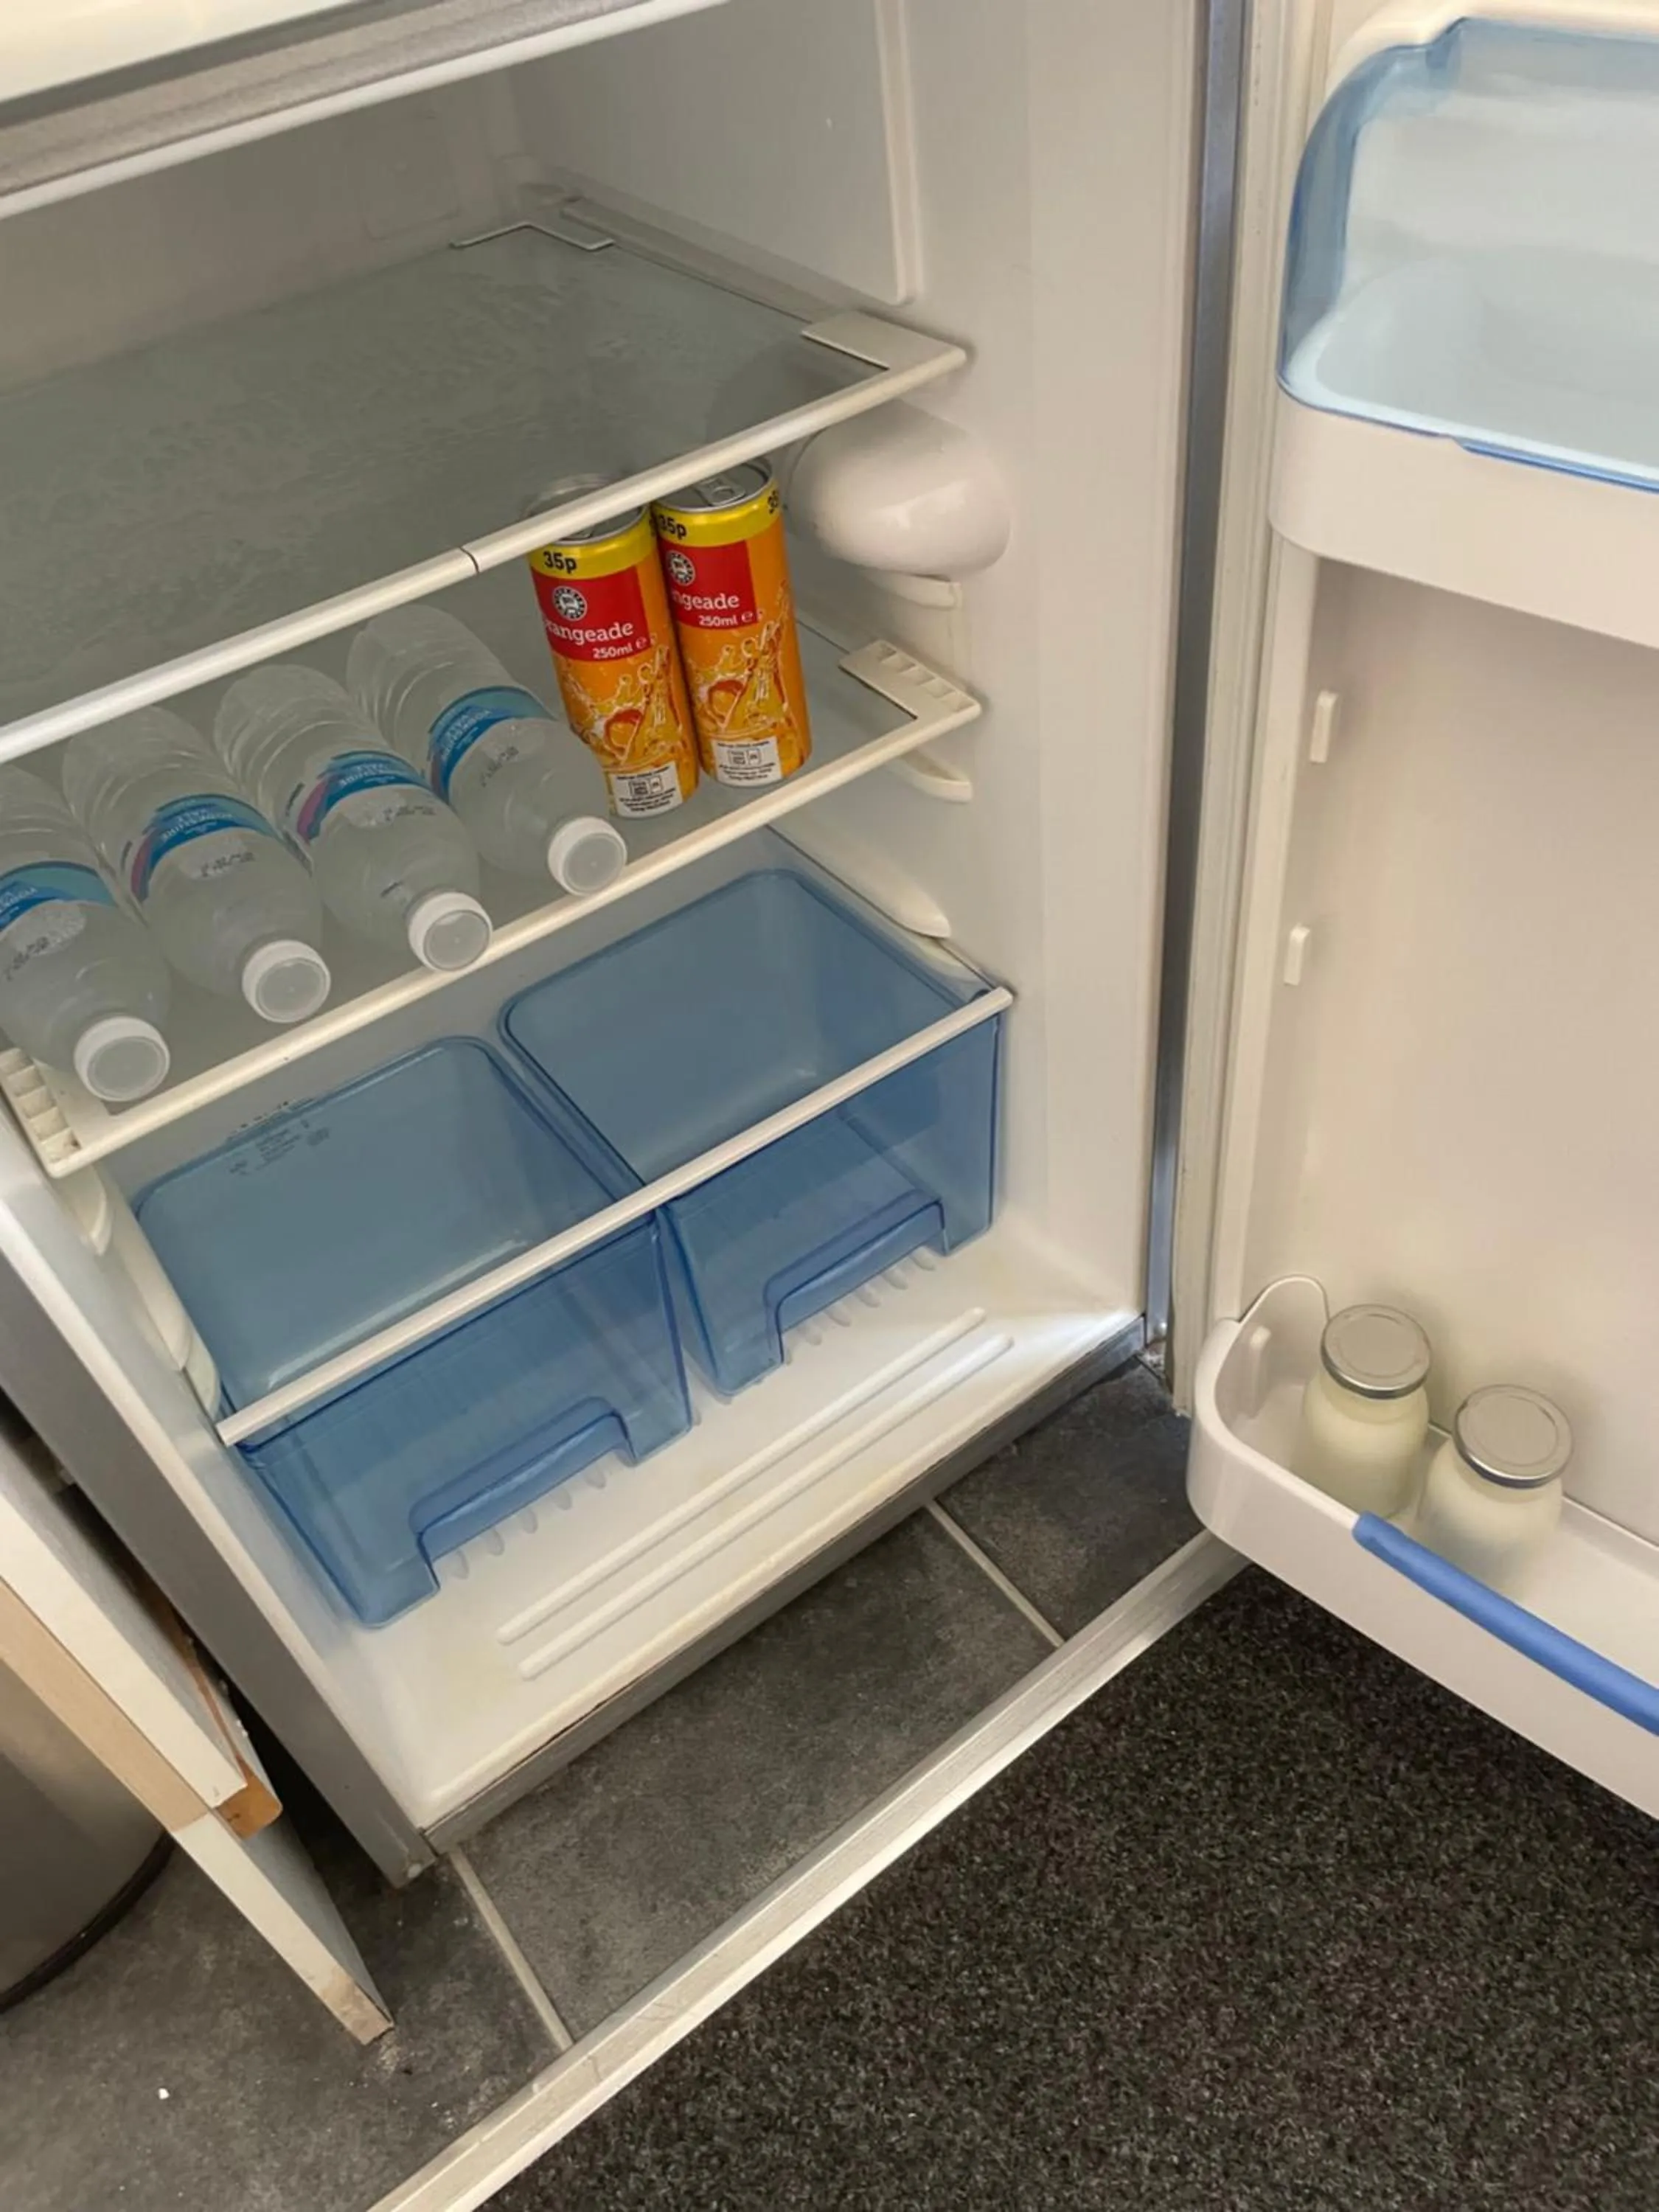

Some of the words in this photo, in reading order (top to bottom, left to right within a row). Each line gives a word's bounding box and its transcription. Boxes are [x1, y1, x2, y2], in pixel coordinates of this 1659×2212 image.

[658, 515, 687, 540] 35p
[543, 551, 577, 574] 35p
[672, 591, 740, 611] ngeade
[699, 615, 738, 627] 250ml
[544, 620, 633, 645] rangeade
[592, 643, 633, 659] 250ml
